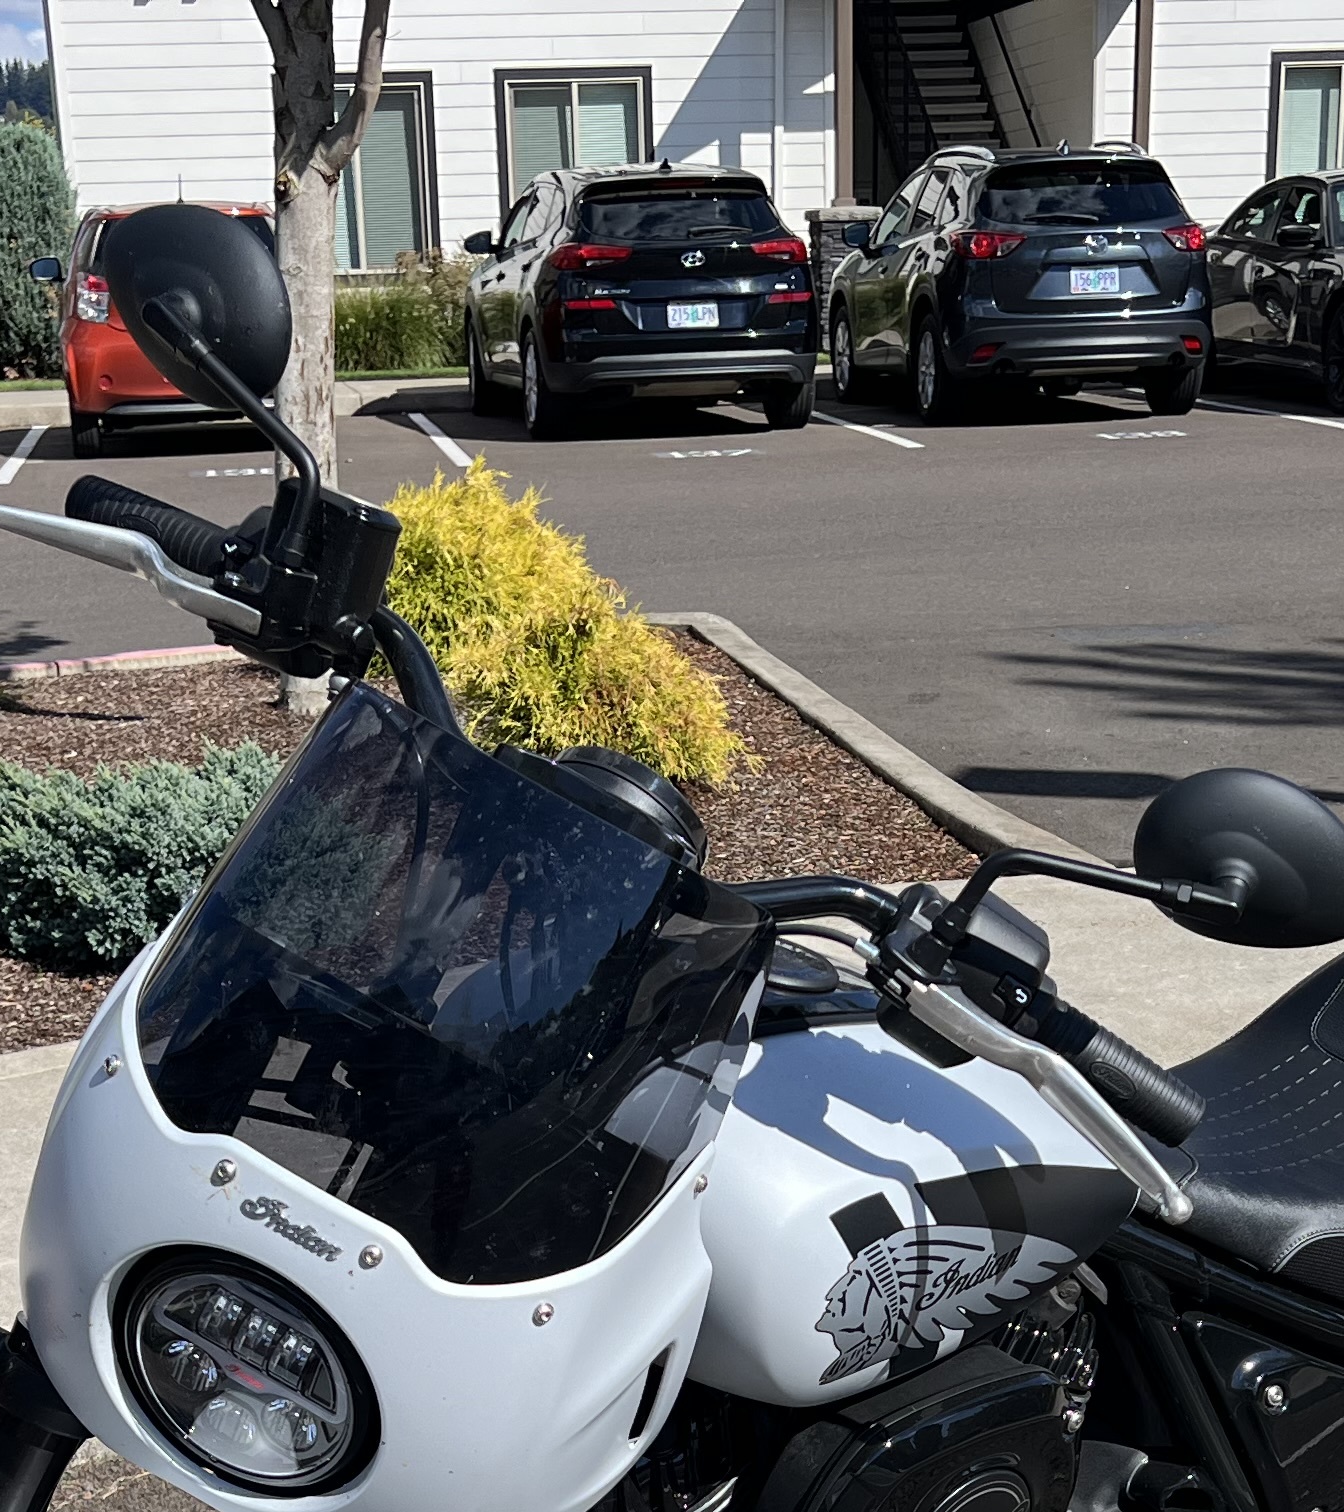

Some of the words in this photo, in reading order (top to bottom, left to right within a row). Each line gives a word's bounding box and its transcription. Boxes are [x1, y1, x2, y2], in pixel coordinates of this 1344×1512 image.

[1074, 273, 1092, 287] 156
[671, 308, 690, 321] 215
[239, 1196, 344, 1262] Indian
[915, 1245, 1022, 1311] Indian
